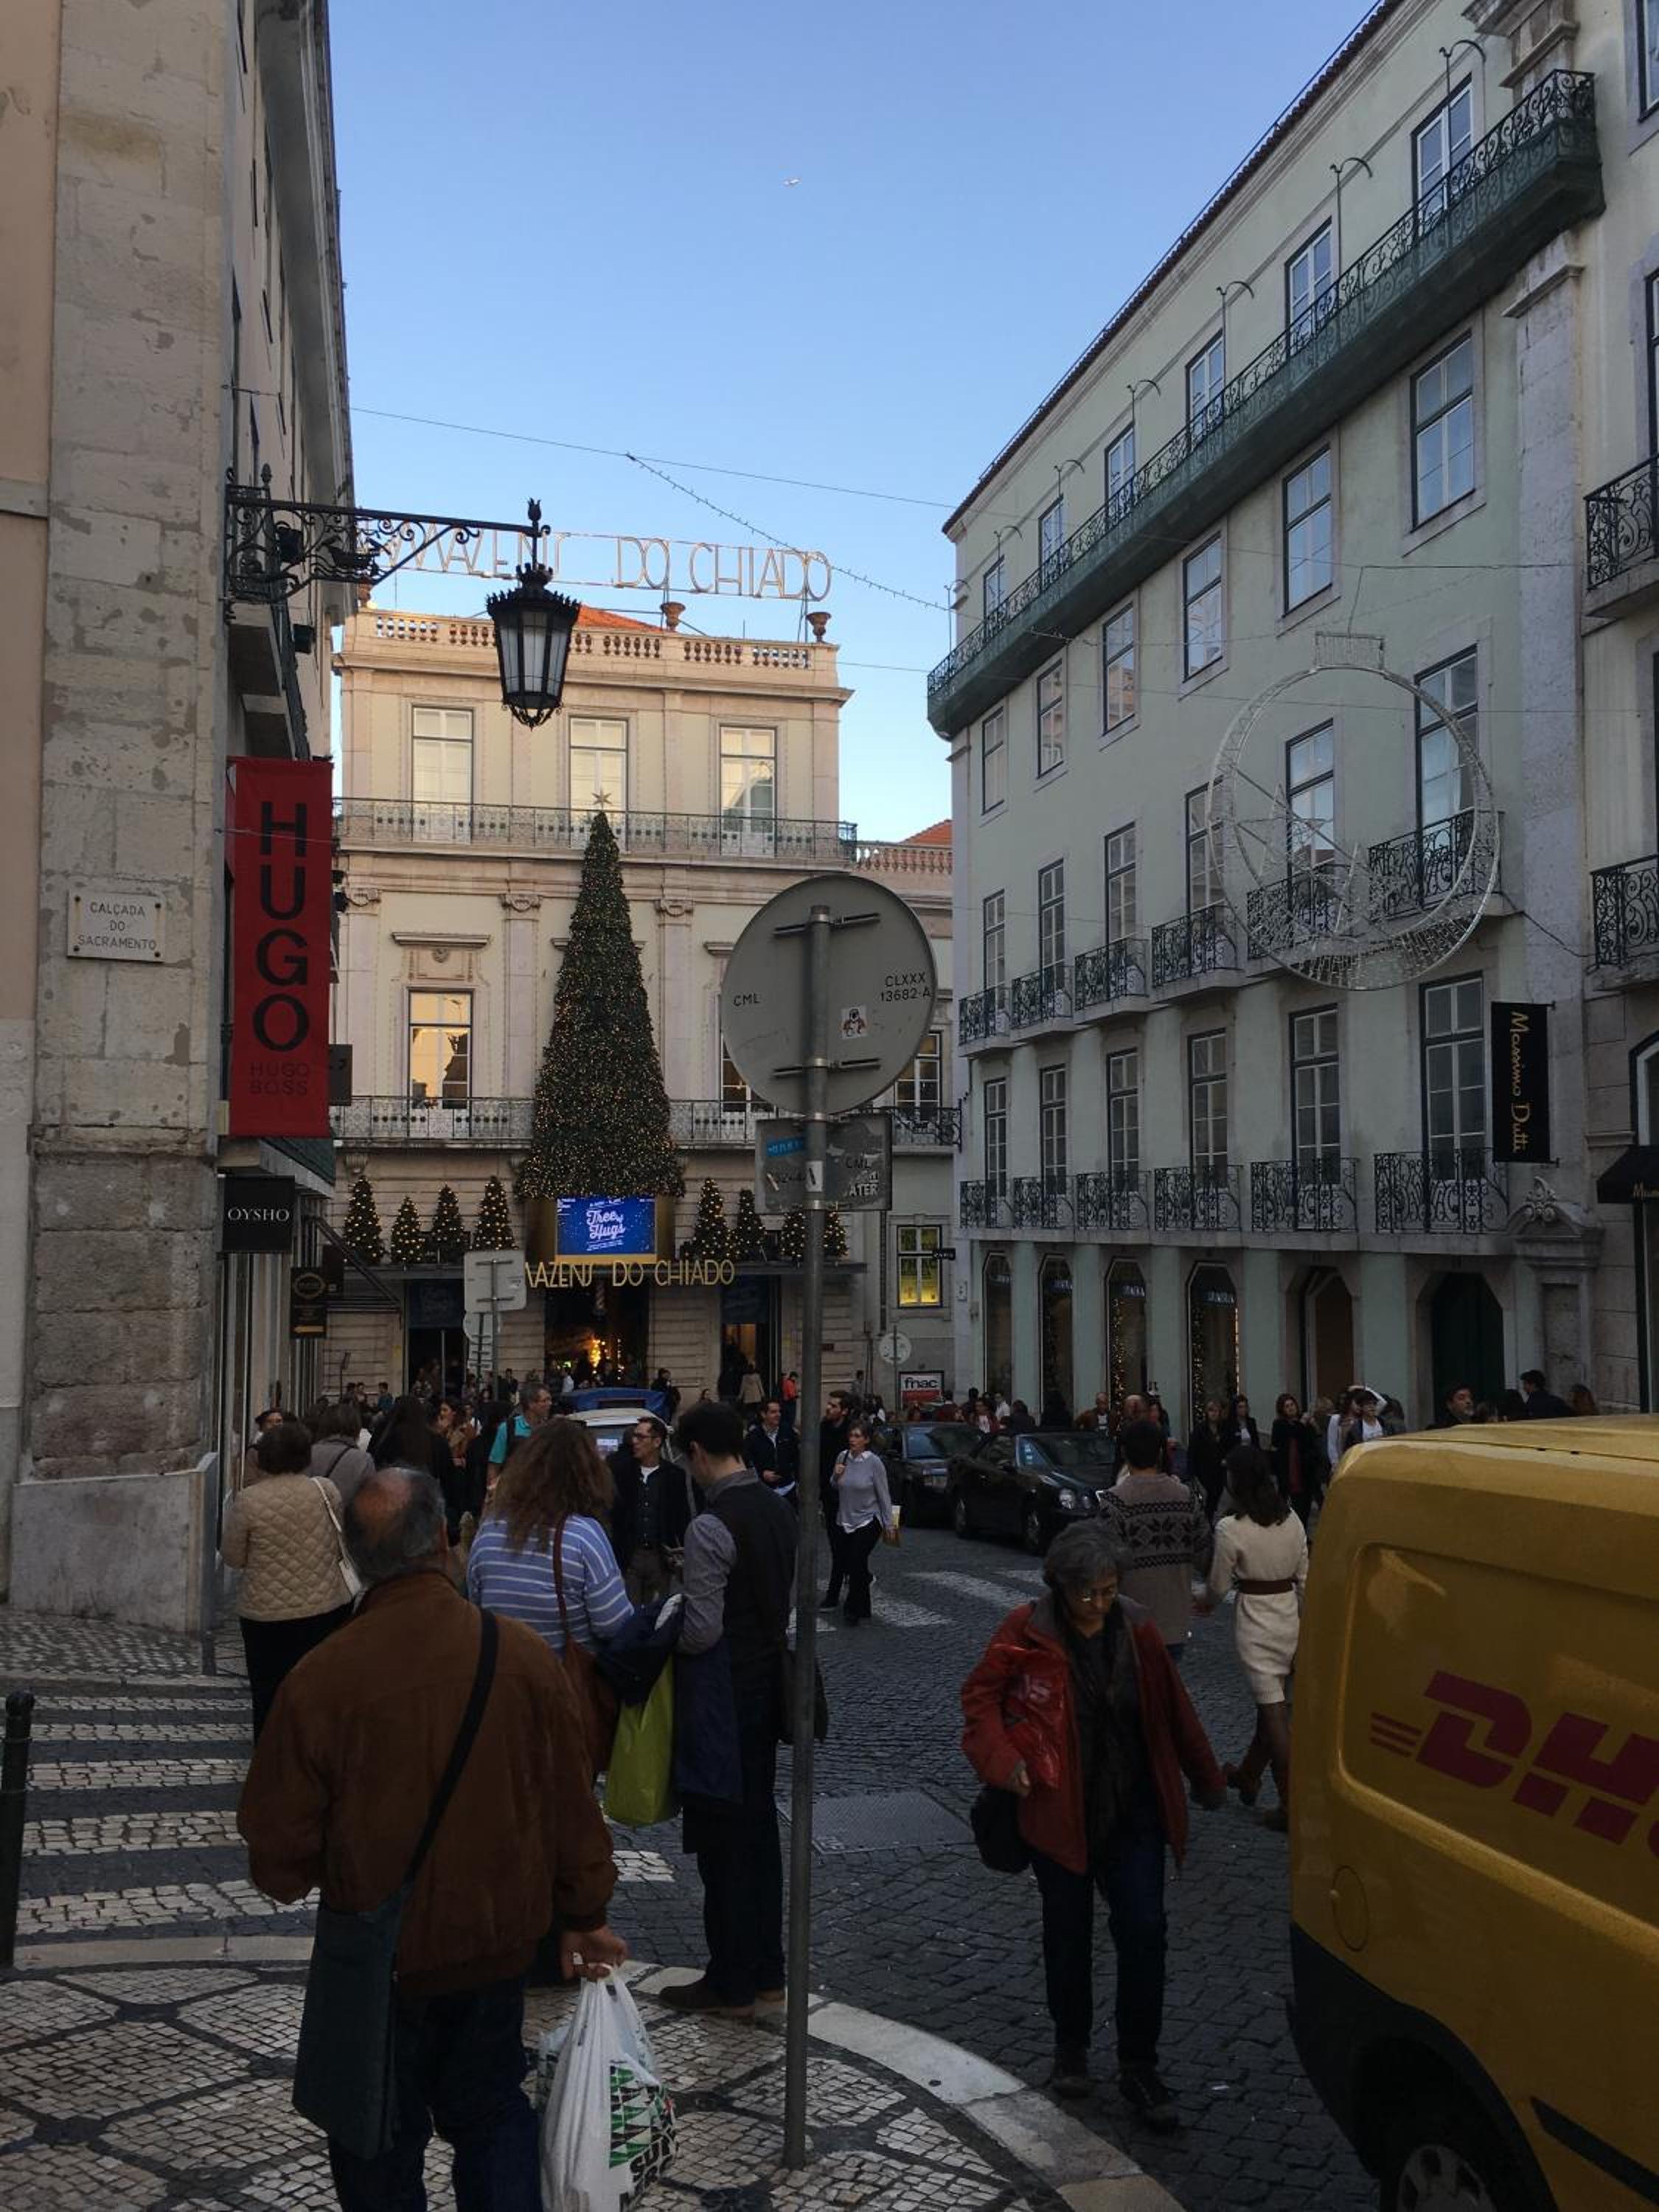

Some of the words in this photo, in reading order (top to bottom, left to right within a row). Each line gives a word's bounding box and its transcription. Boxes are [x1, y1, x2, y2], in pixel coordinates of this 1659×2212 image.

[616, 535, 669, 590] DO
[690, 543, 832, 602] CHIADO
[109, 920, 126, 931] DO
[252, 801, 310, 1051] HUGO
[77, 933, 157, 951] SACRAMENTO
[885, 972, 926, 987] CLXXX
[733, 992, 762, 1006] CML
[1509, 1011, 1531, 1097] Massimo
[248, 1061, 310, 1077] HUGO
[248, 1079, 308, 1096] BOSS
[227, 1207, 291, 1222] OYSHO
[612, 1259, 644, 1287] DO
[654, 1259, 735, 1286] CHIADO
[904, 1377, 939, 1389] fnac
[1416, 1670, 1659, 1860] DH
